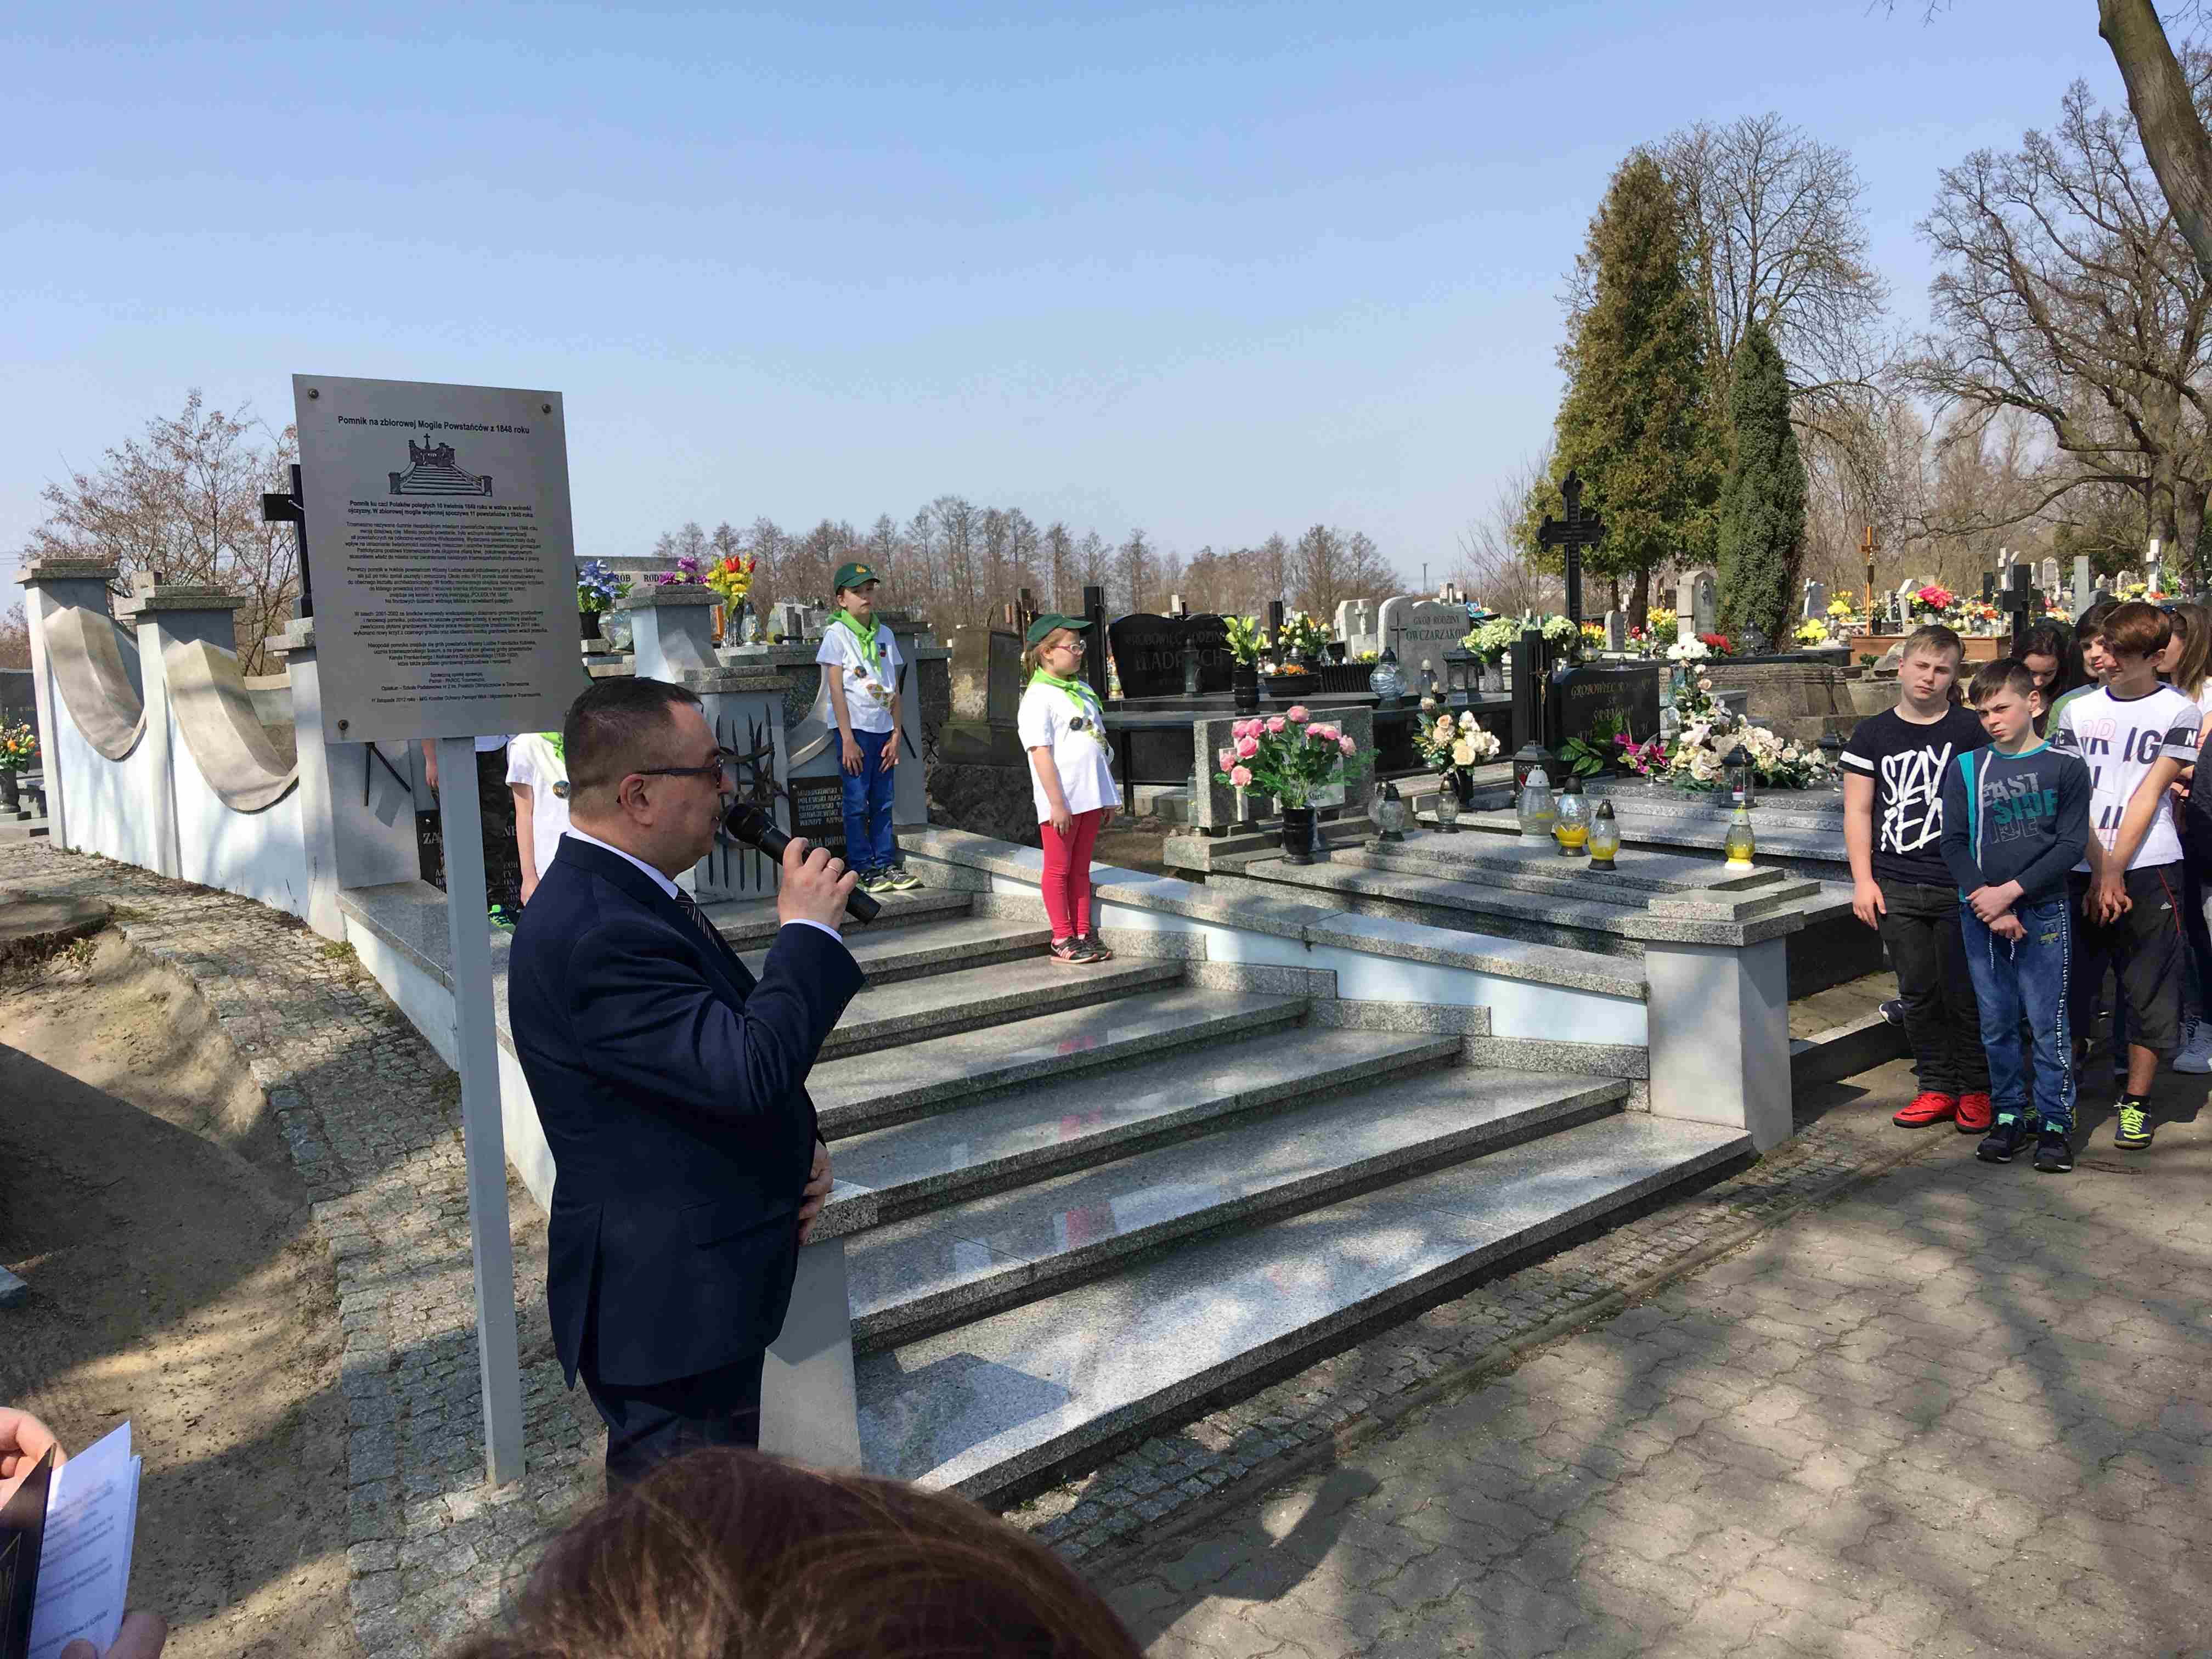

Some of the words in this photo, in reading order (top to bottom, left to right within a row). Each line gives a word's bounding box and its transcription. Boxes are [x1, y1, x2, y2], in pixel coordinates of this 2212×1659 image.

[338, 416, 367, 425] Pomnik
[380, 419, 416, 429] zbiorowej
[419, 420, 442, 430] Mogile
[444, 421, 489, 432] Powstańców
[496, 425, 512, 433] 1848
[1881, 742, 1952, 806] STAY
